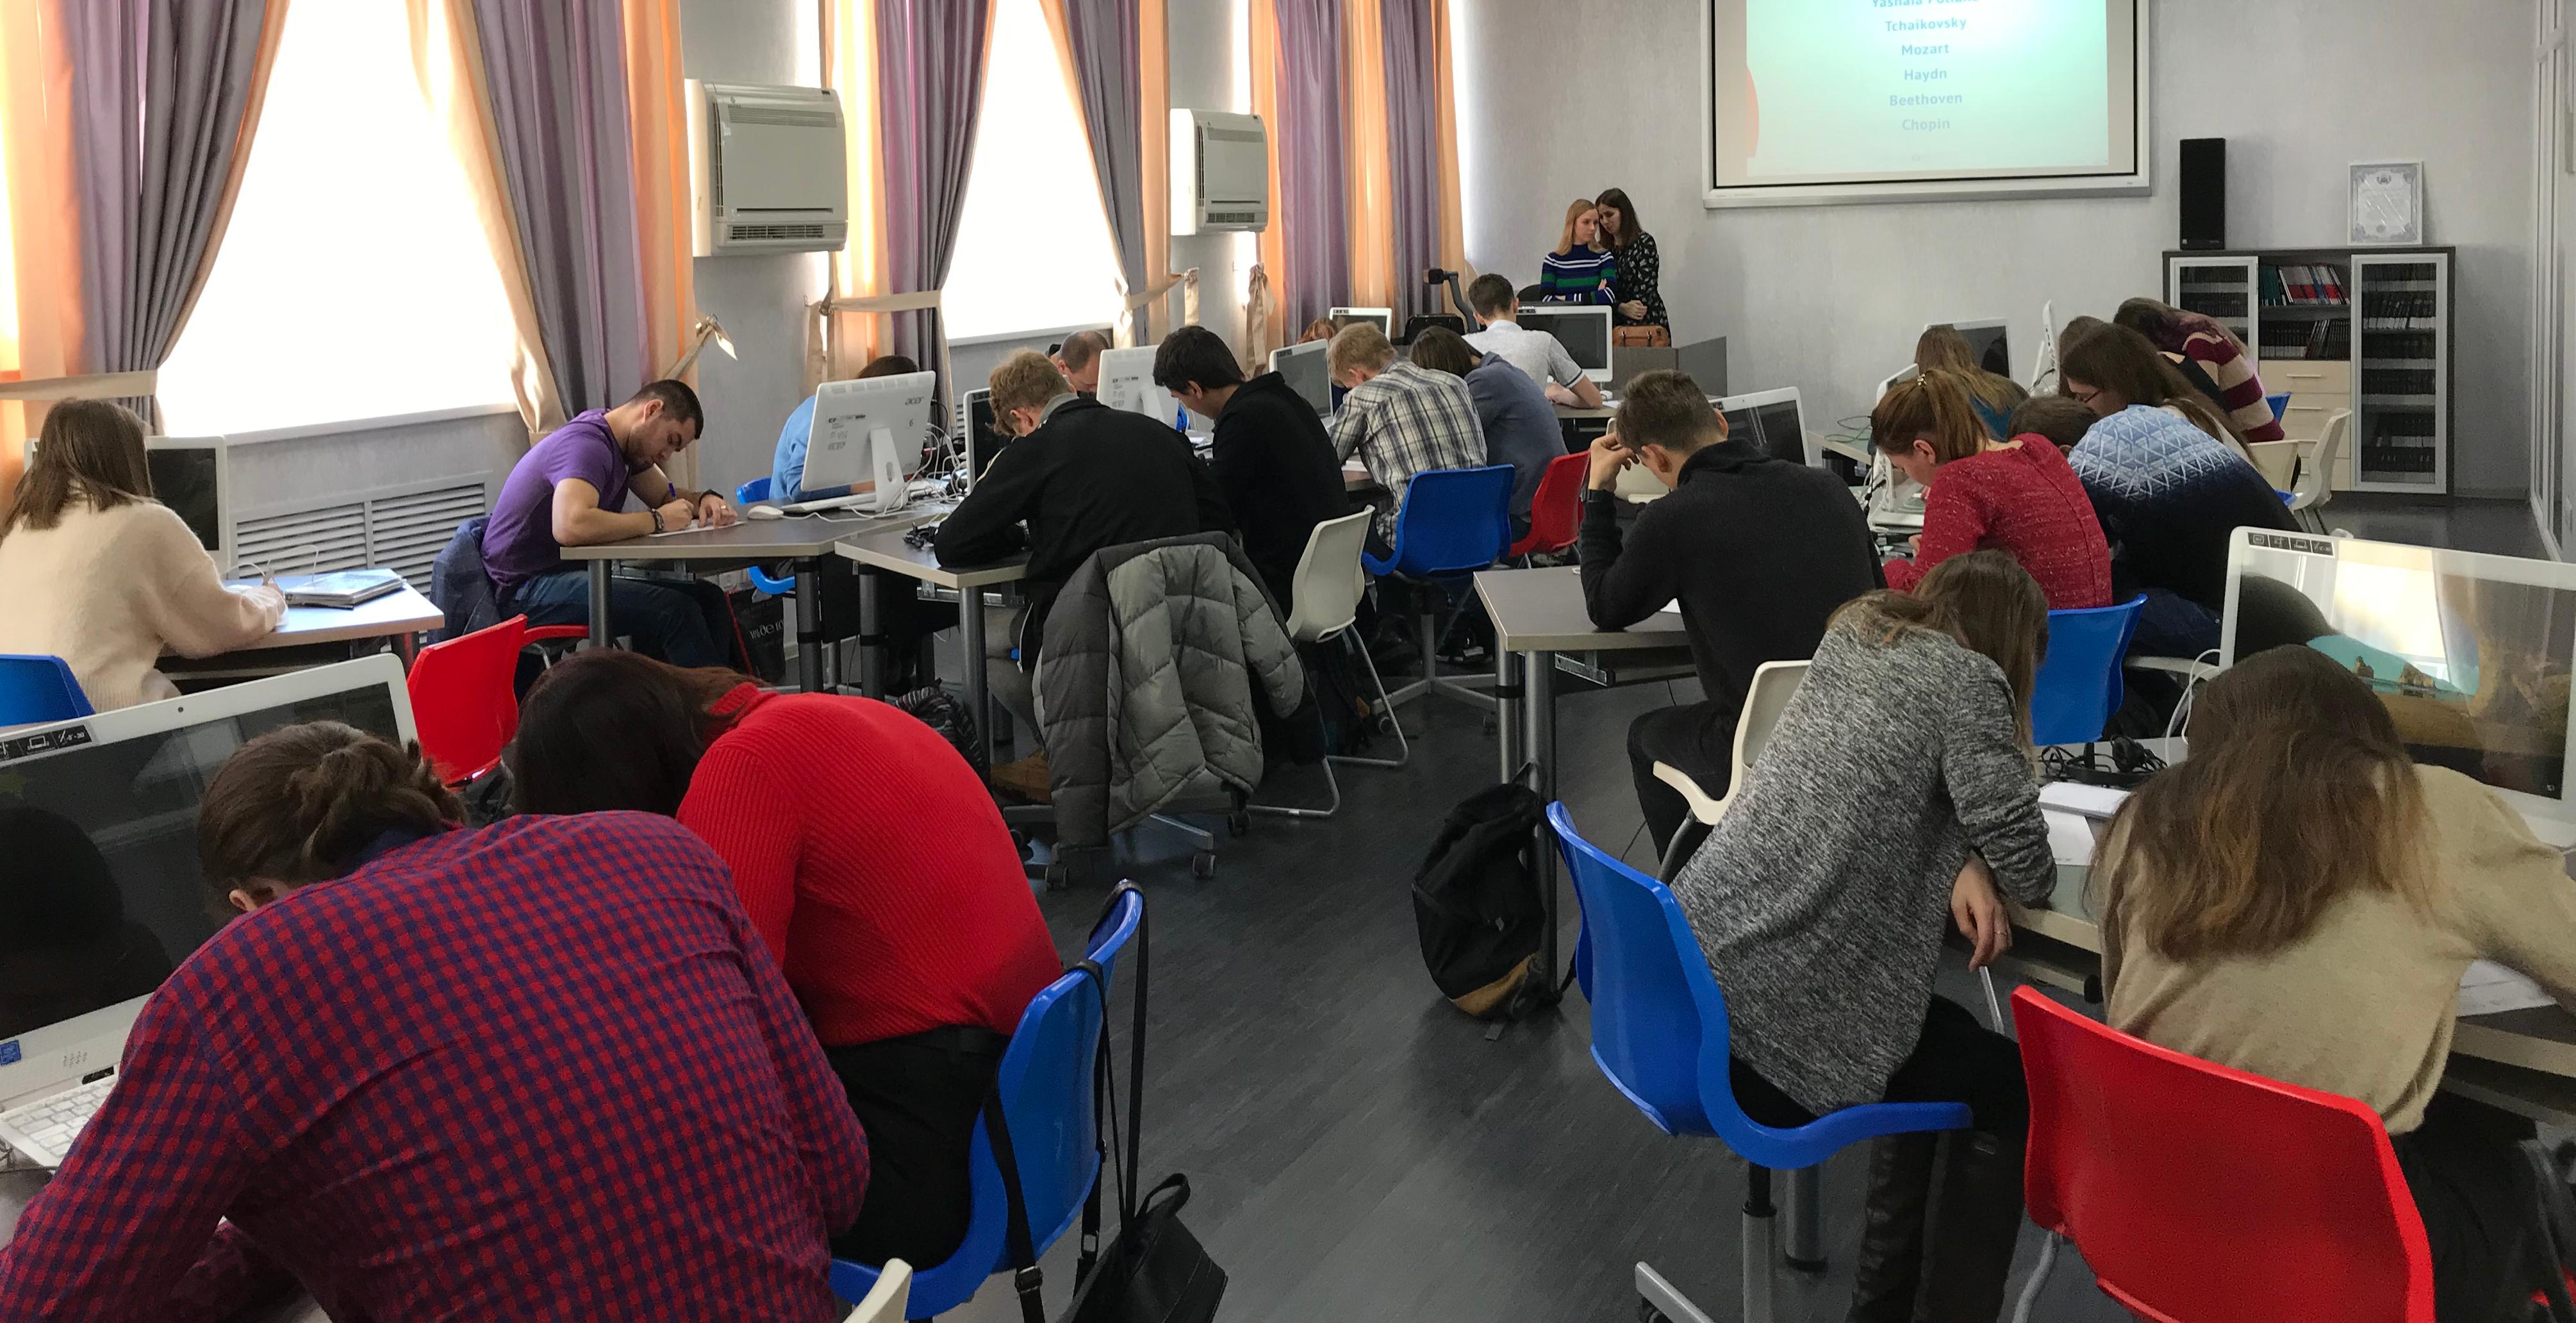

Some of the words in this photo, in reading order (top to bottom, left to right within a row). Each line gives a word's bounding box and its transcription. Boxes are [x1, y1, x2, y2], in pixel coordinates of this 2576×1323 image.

[1885, 17, 1967, 31] Tchaikovsky
[1901, 44, 1950, 56] Mozart
[1904, 69, 1947, 82] Haydn
[1890, 94, 1963, 106] Beethoven
[1902, 119, 1950, 131] Chopin
